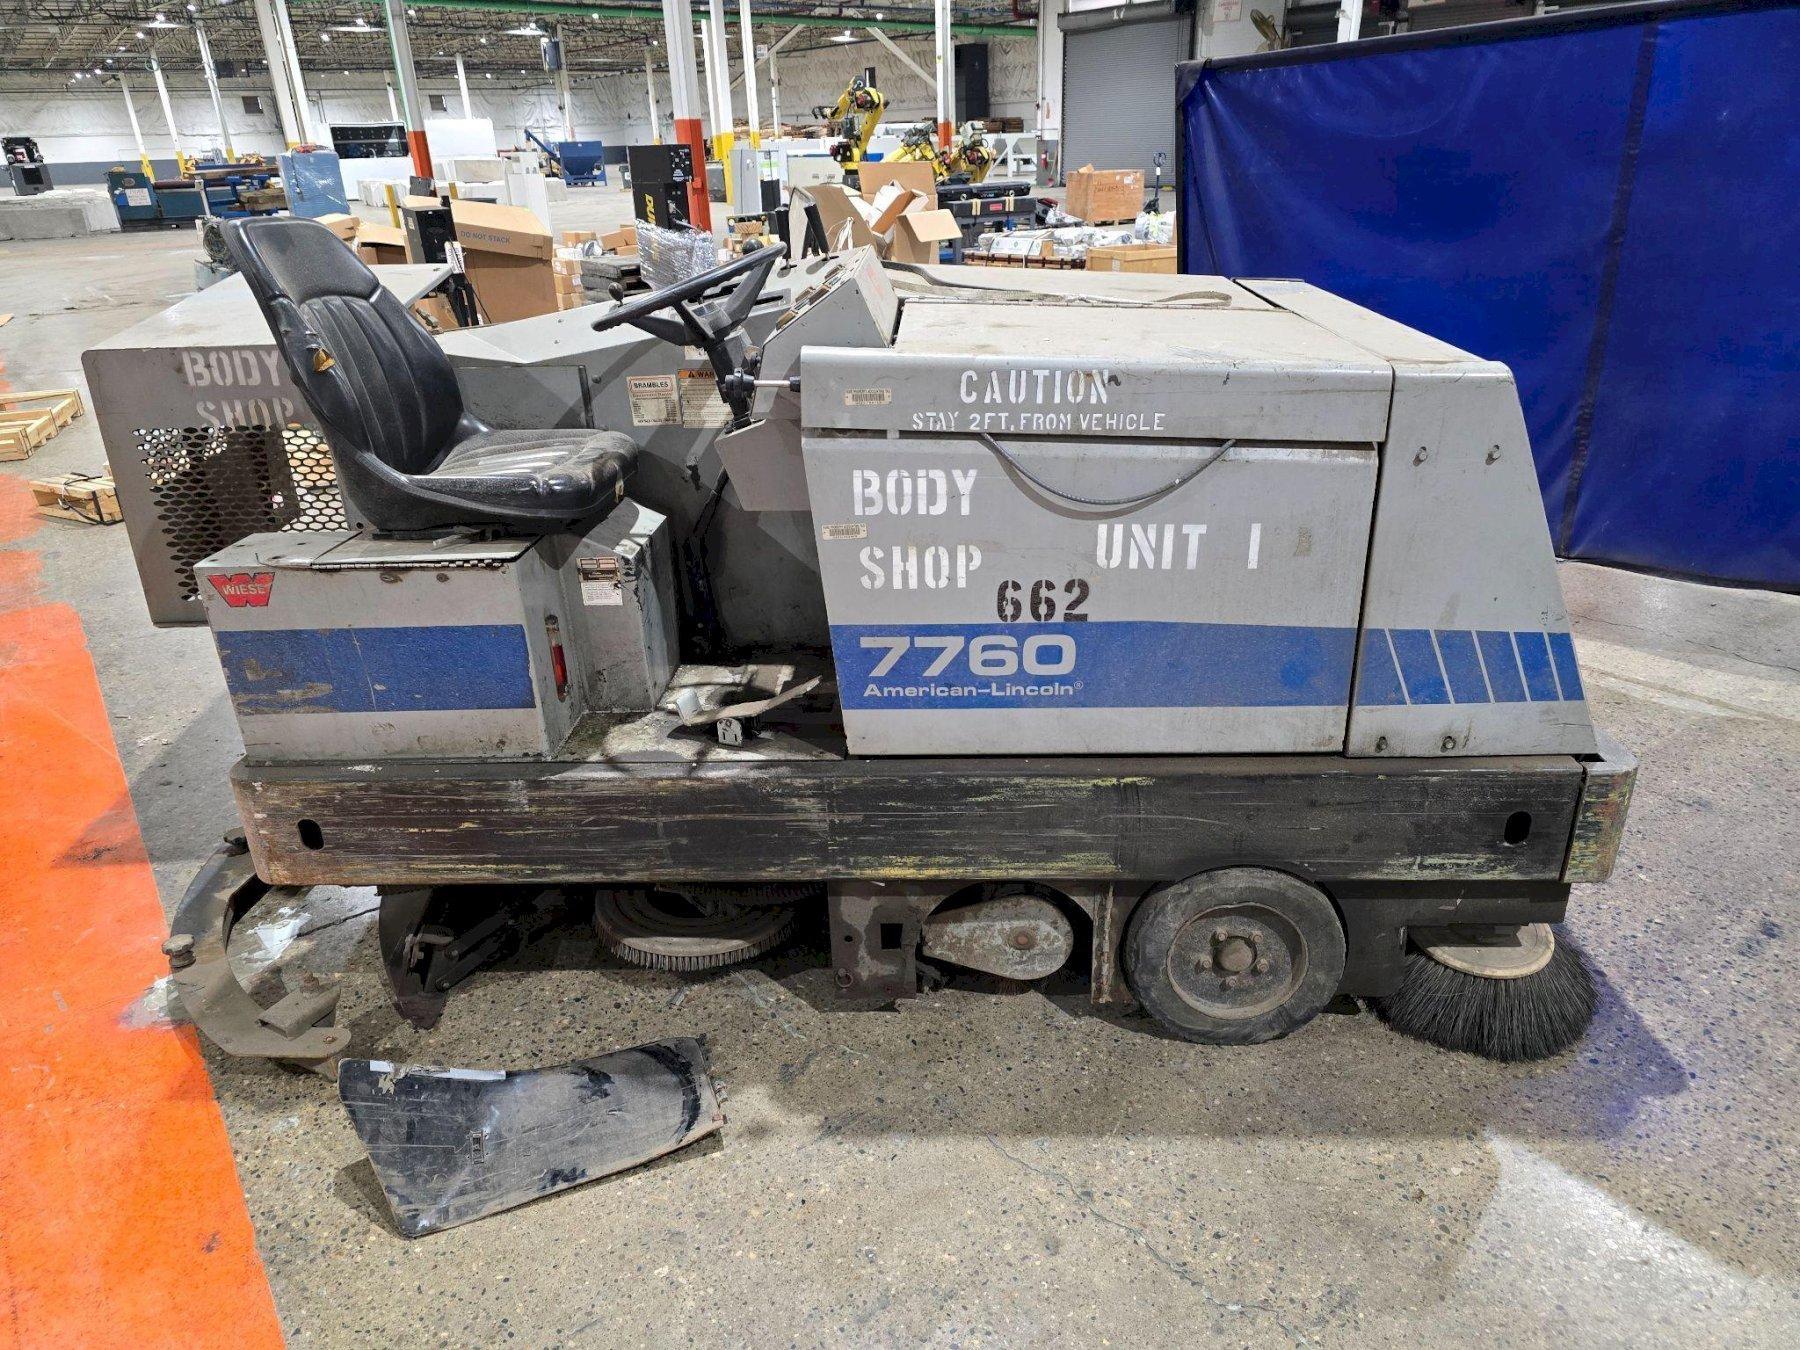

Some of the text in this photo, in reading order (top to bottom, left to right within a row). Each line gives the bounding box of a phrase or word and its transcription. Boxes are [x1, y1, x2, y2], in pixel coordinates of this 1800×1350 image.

[460, 230, 511, 244] DO NOT STACK
[181, 350, 281, 386] BODY
[633, 381, 669, 389] BRAMBLES
[959, 367, 1109, 405] CAUTION
[196, 397, 294, 434] SHOP
[911, 411, 960, 431] STAY
[1079, 412, 1166, 431] VEHICLE
[852, 468, 978, 517] BODY
[1096, 523, 1208, 570] UNIT
[859, 544, 983, 590] SHOP
[221, 582, 267, 595] WIESE
[996, 577, 1091, 623] 662
[859, 633, 1077, 678] 7760
